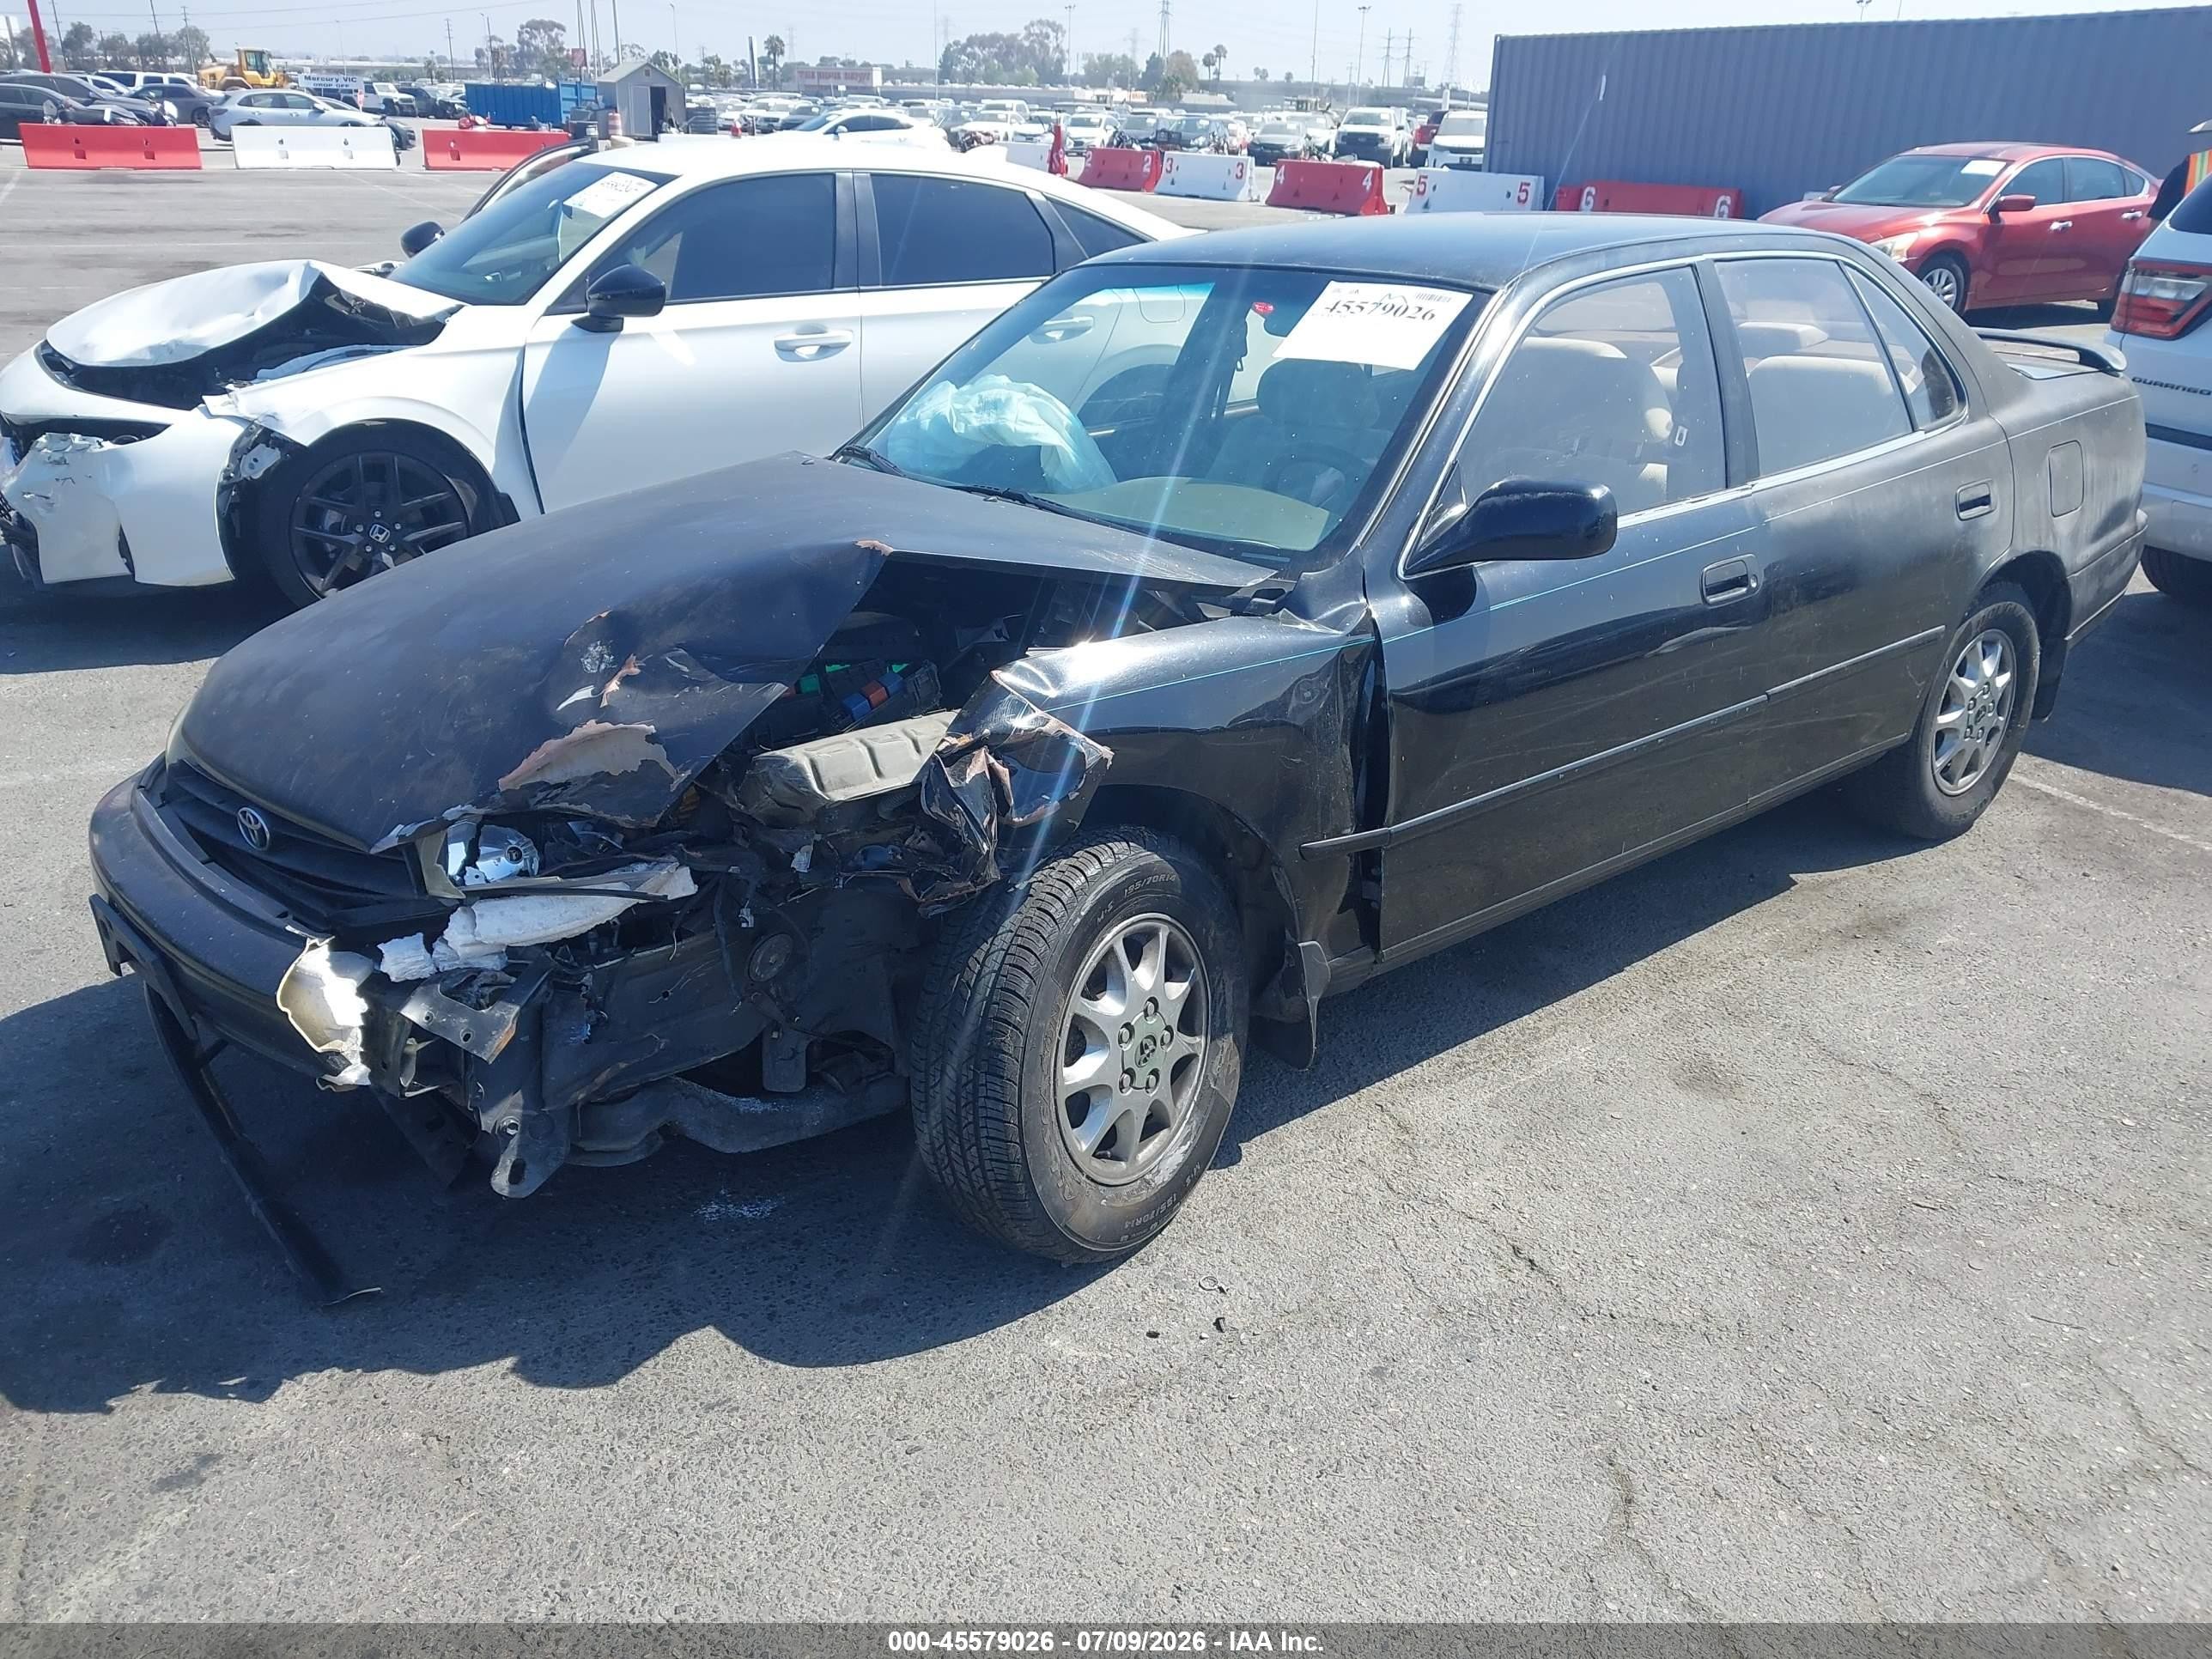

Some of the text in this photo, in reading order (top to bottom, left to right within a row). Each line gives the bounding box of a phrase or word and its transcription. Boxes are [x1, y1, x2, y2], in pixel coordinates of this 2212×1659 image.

[304, 75, 339, 83] Mercury
[1085, 150, 1092, 167] 2
[1143, 154, 1152, 173] 2
[1165, 157, 1173, 173] 3
[1236, 161, 1244, 179] 3
[1276, 164, 1285, 185] 4
[1362, 169, 1373, 191] 4
[1417, 174, 1428, 196] 5
[1517, 181, 1530, 204] 5
[1580, 186, 1596, 212] 6
[1324, 300, 1436, 321] 45579026
[2131, 376, 2211, 396] DURANGO
